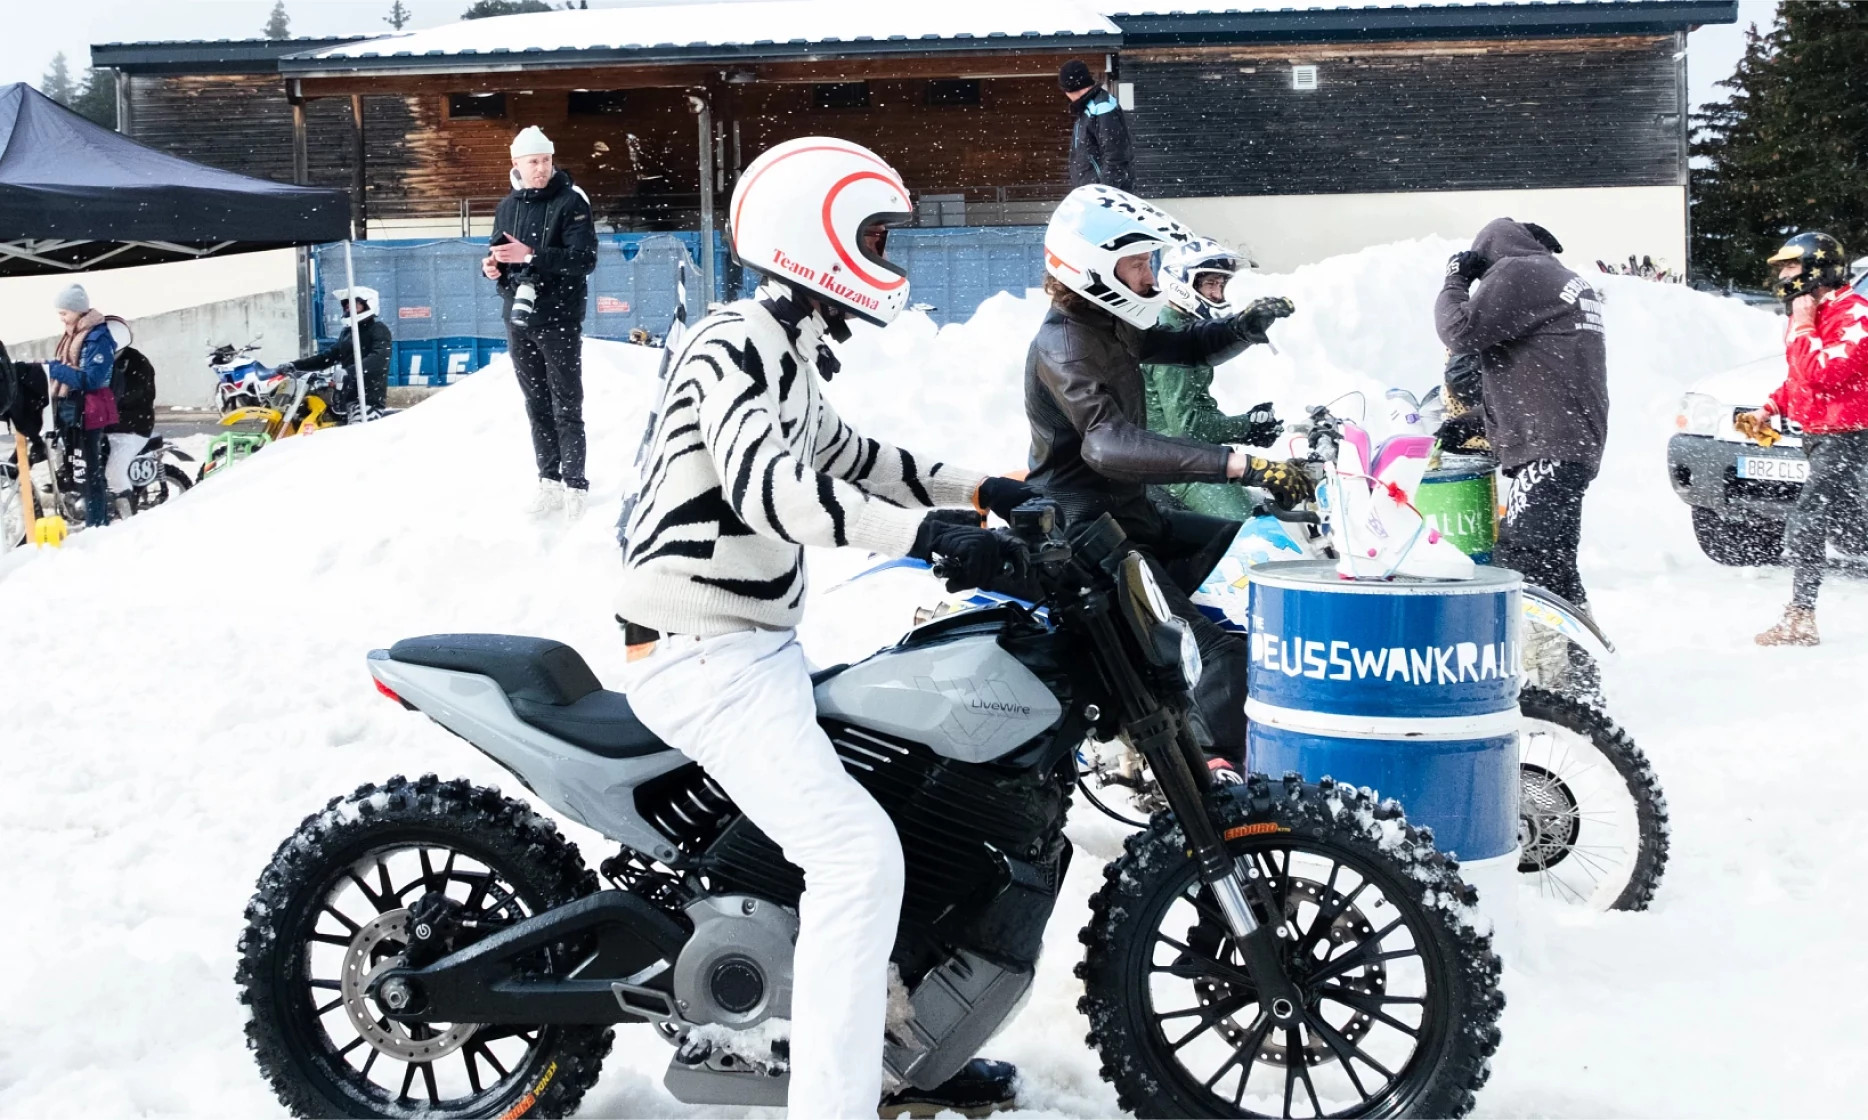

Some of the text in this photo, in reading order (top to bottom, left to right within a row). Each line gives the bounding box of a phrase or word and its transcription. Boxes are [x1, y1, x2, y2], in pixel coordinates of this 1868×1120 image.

[773, 249, 880, 311] Team Ikuzawa
[129, 460, 155, 481] 68
[1748, 460, 1805, 480] 882 CLS
[971, 699, 1031, 715] LiveWire
[1224, 822, 1278, 841] ENDURO
[533, 1061, 557, 1097] KENDA
